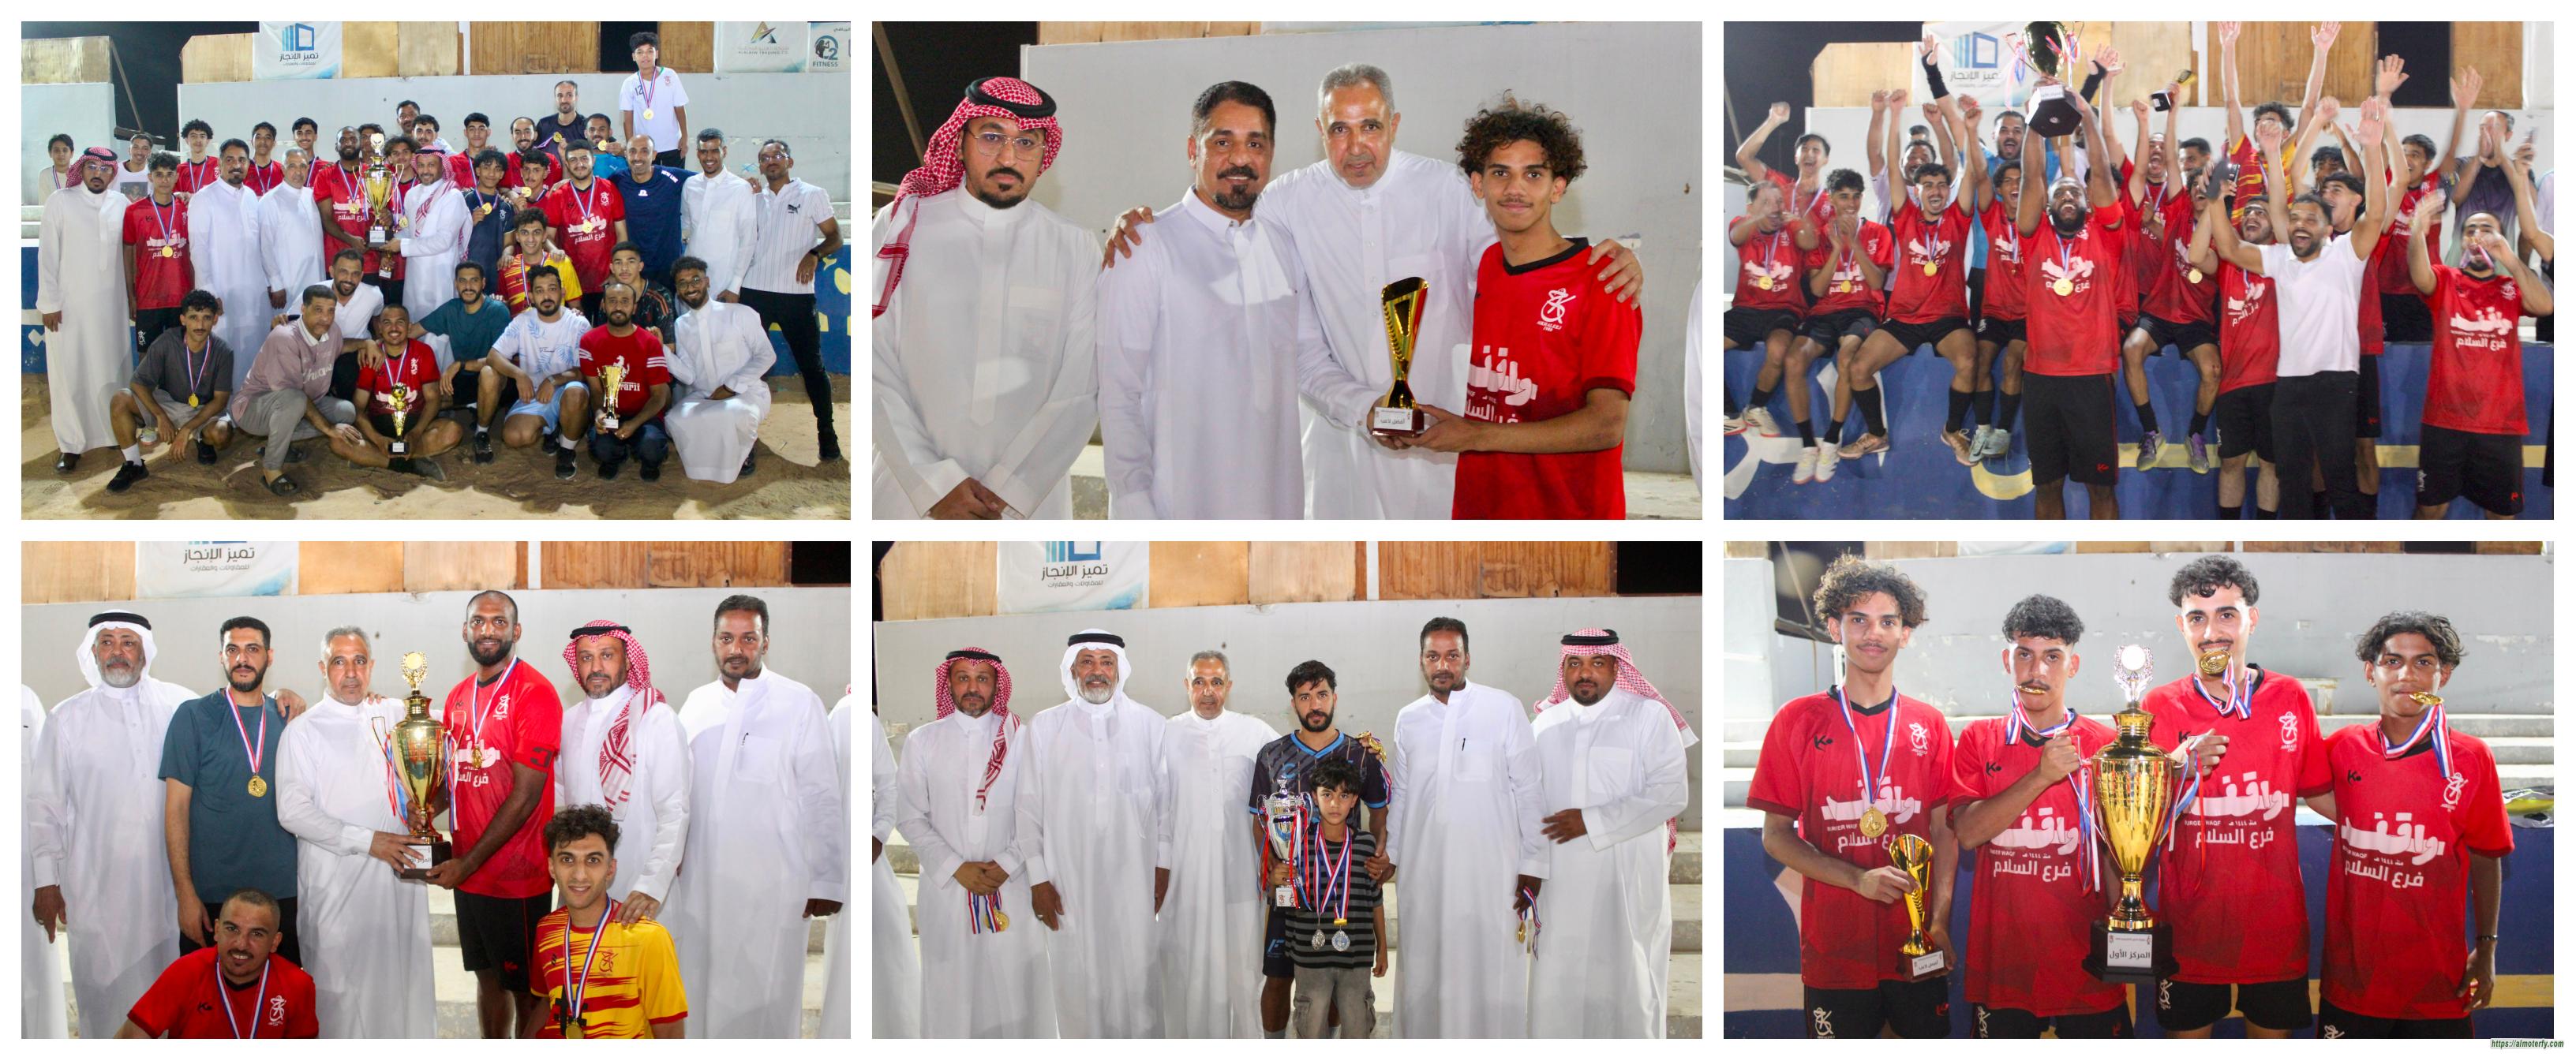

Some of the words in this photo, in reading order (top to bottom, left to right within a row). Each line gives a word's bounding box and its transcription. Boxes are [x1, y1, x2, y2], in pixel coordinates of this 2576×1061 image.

[2455, 337, 2488, 349] السلام
[2489, 336, 2507, 351] فرع
[227, 547, 255, 563] تميز
[1081, 563, 1108, 579] تميز
[473, 772, 489, 788] فرع
[2195, 828, 2245, 849] السلام
[2248, 826, 2275, 850] فرع
[1993, 858, 2038, 878] السلام
[2042, 861, 2072, 883] فرع
[2344, 860, 2390, 883] السلام
[2391, 871, 2425, 889] فرع
[2109, 948, 2127, 959] الأول
[2128, 950, 2151, 960] المركز
